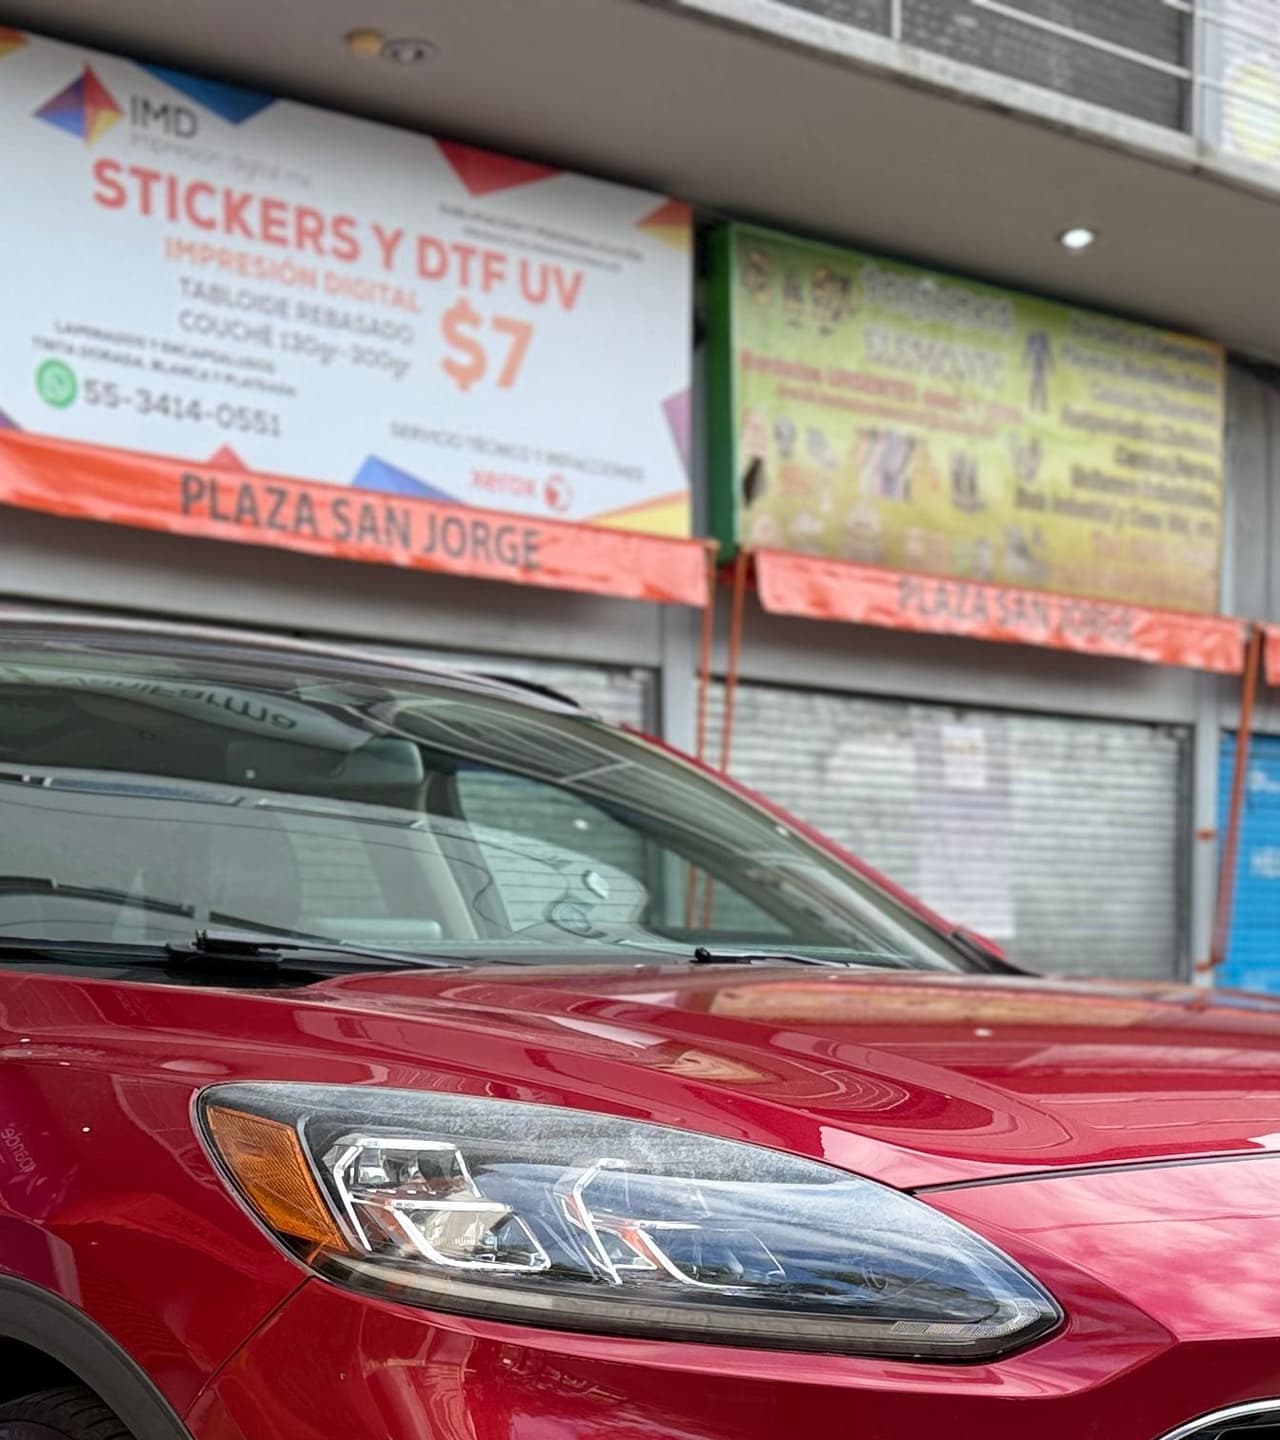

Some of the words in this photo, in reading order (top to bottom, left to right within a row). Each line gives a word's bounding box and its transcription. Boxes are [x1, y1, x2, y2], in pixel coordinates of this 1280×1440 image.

[130, 94, 199, 140] IMD
[91, 156, 361, 264] STICKERS
[371, 222, 406, 272] Y
[415, 233, 509, 294] DTF
[519, 258, 585, 312] UV
[164, 236, 317, 290] IMPRESIÓN
[323, 270, 422, 316] DIGITAL
[180, 276, 289, 319] TABLOIDE
[295, 300, 415, 346] REBASADO
[440, 296, 534, 392] $7
[82, 378, 282, 437] 55-3414-0551
[180, 473, 322, 537] PLAZA
[330, 498, 413, 550] SAN
[422, 513, 546, 569] JORGE
[897, 575, 989, 620] PLAZA
[997, 589, 1051, 628] SAN
